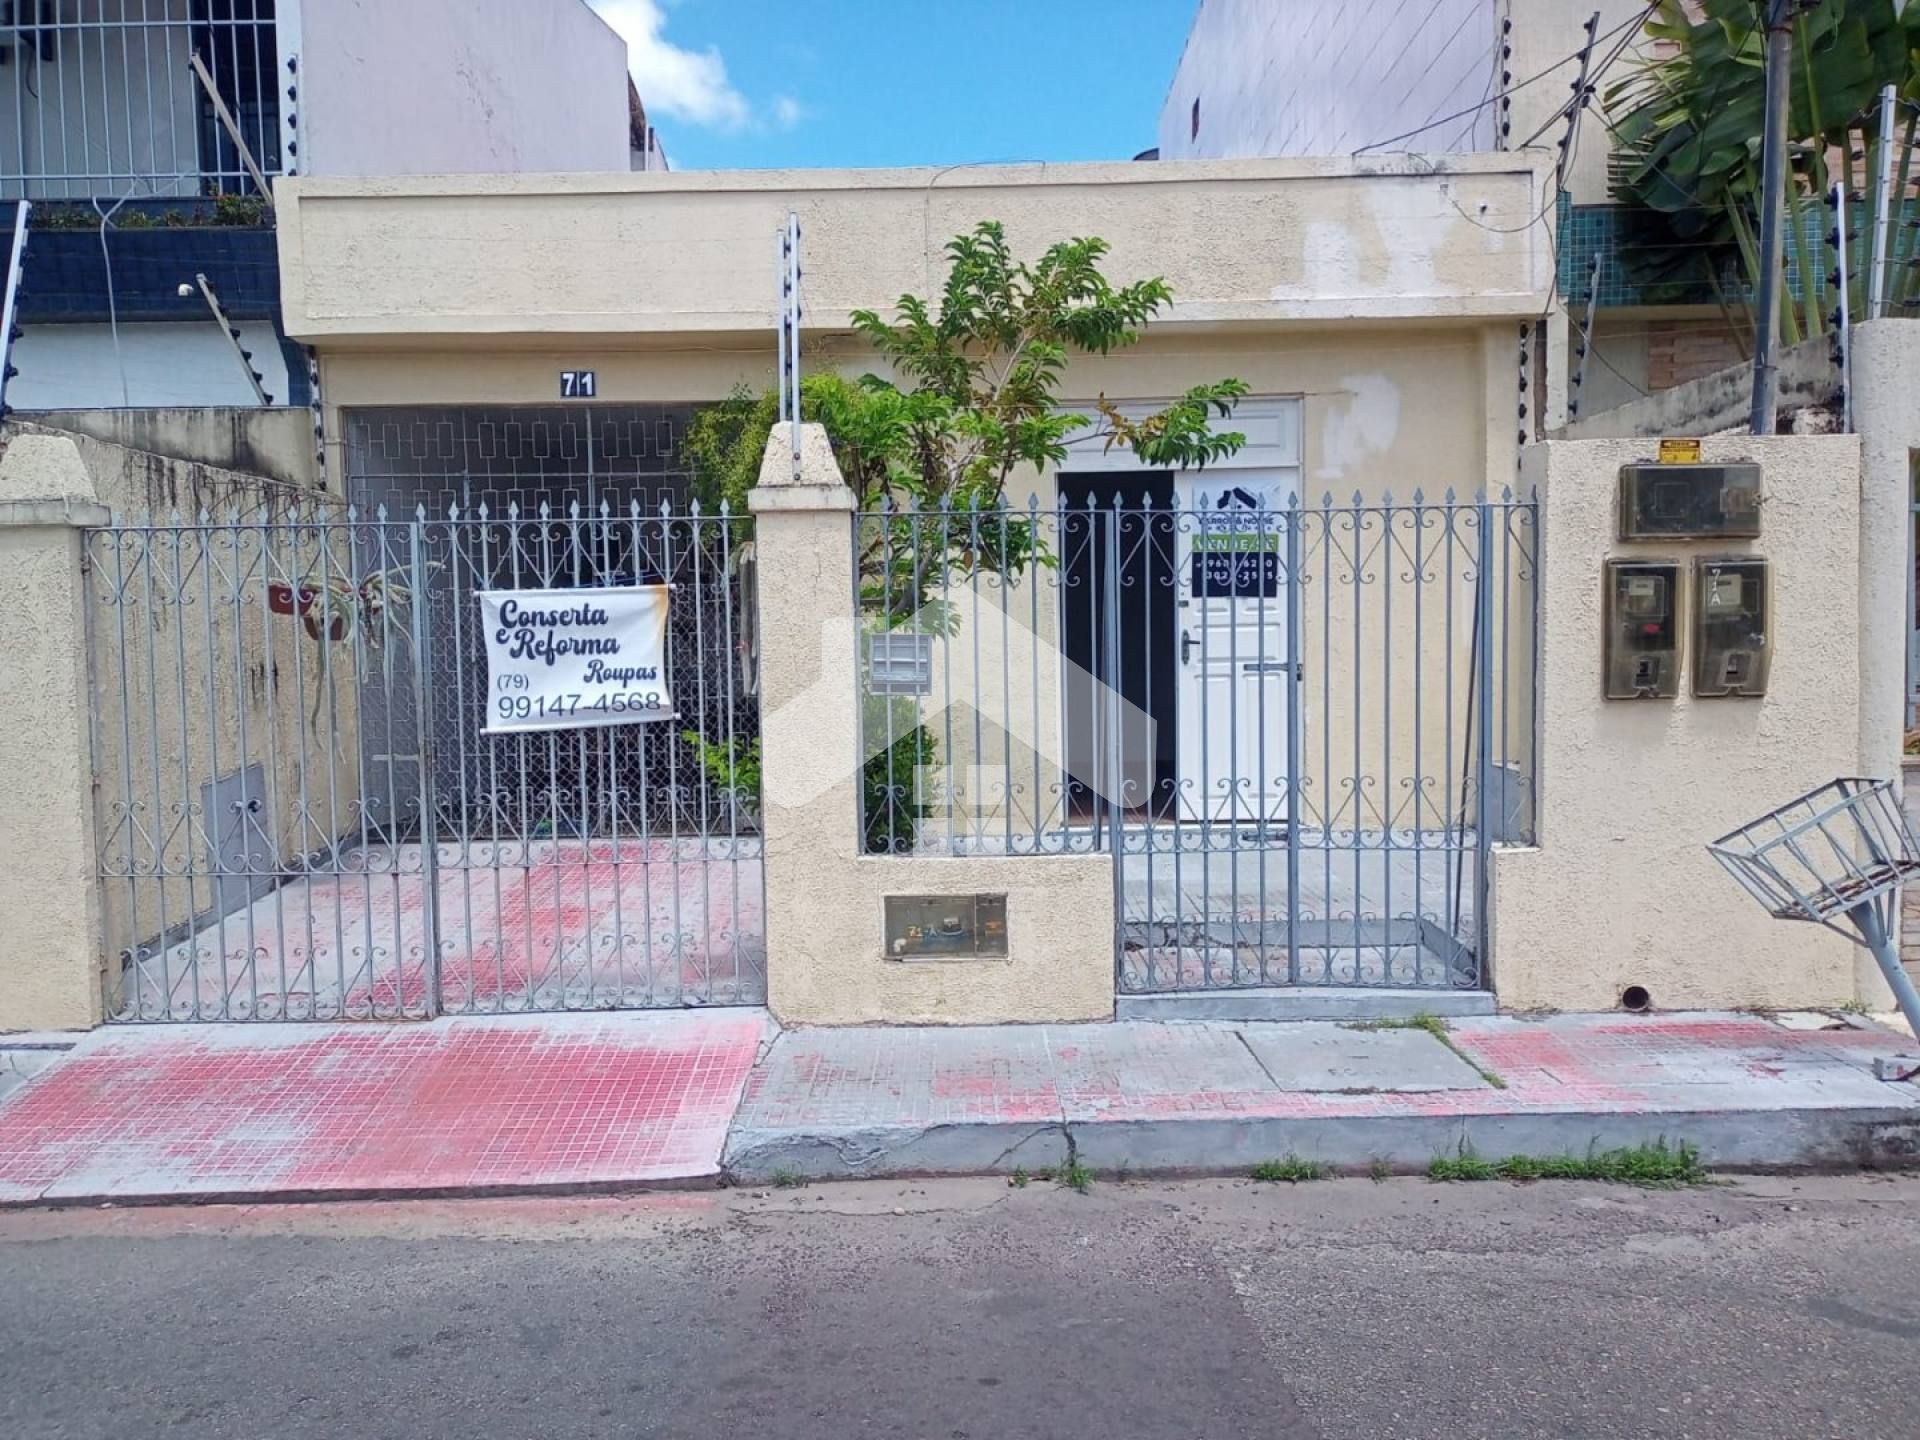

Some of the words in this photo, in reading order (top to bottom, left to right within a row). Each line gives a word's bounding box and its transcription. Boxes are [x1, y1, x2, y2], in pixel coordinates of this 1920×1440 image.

[562, 372, 593, 396] 71
[1195, 539, 1275, 550] VENEE
[499, 599, 609, 629] Conserta
[495, 628, 511, 644] e
[509, 628, 621, 666] Reforma
[497, 674, 529, 691] (79)
[583, 659, 657, 688] Roupas
[498, 692, 661, 719] 99147-4568
